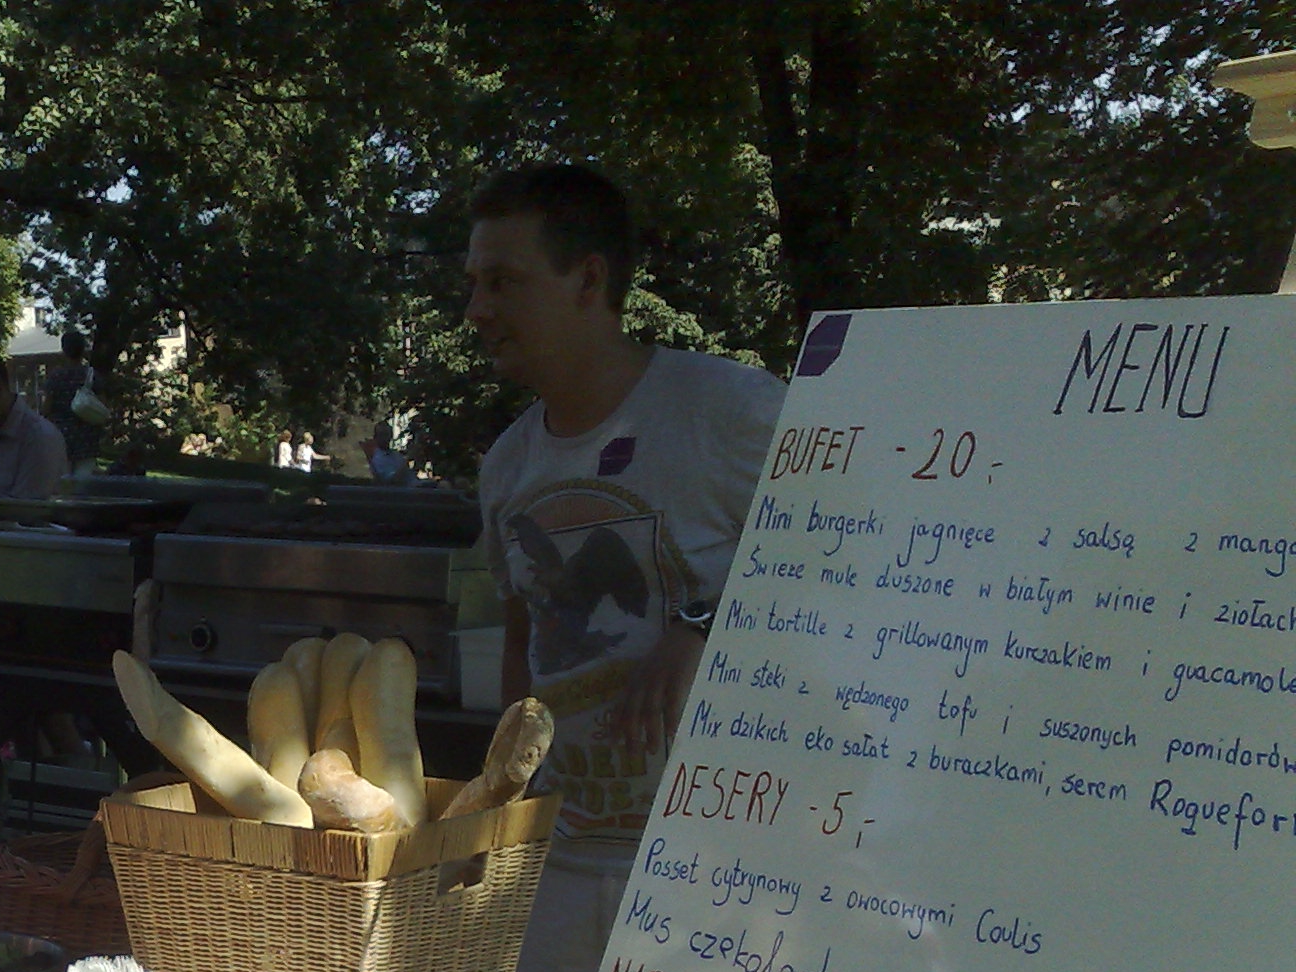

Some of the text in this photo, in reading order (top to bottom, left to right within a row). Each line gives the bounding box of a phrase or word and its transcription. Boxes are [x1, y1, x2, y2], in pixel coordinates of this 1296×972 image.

[1052, 322, 1230, 418] MENU
[769, 425, 865, 481] BUFET
[755, 495, 794, 530] Mini
[806, 500, 884, 556] burgerki
[897, 517, 995, 568] jagnięce
[1073, 522, 1135, 558] salsą
[876, 564, 954, 596] duszone
[1006, 576, 1073, 614] białym
[1095, 586, 1155, 613] winie
[1180, 592, 1191, 619] i
[725, 599, 760, 630] Mini
[767, 601, 827, 635] tortille
[872, 620, 988, 678] grillowanym
[1004, 630, 1111, 671] kurczakiem
[1142, 650, 1151, 676] i
[708, 650, 741, 684] Mini
[750, 660, 786, 689] steki
[835, 681, 909, 722] wędzonego
[939, 689, 977, 736] tofu
[1003, 705, 1013, 734] i
[1039, 717, 1136, 749] suszonych
[663, 762, 790, 826] DESERY
[689, 700, 722, 738] Mix
[730, 711, 788, 743] dzikich
[804, 726, 834, 751] eko
[842, 733, 889, 759] sałat
[1061, 773, 1127, 801] serem
[1150, 778, 1296, 850] Roquefor
[625, 889, 672, 944] Mus
[644, 838, 699, 884] Posset
[711, 858, 802, 915] cytrynowy
[846, 890, 955, 940] owocowymi
[976, 908, 1042, 954] Coulis
